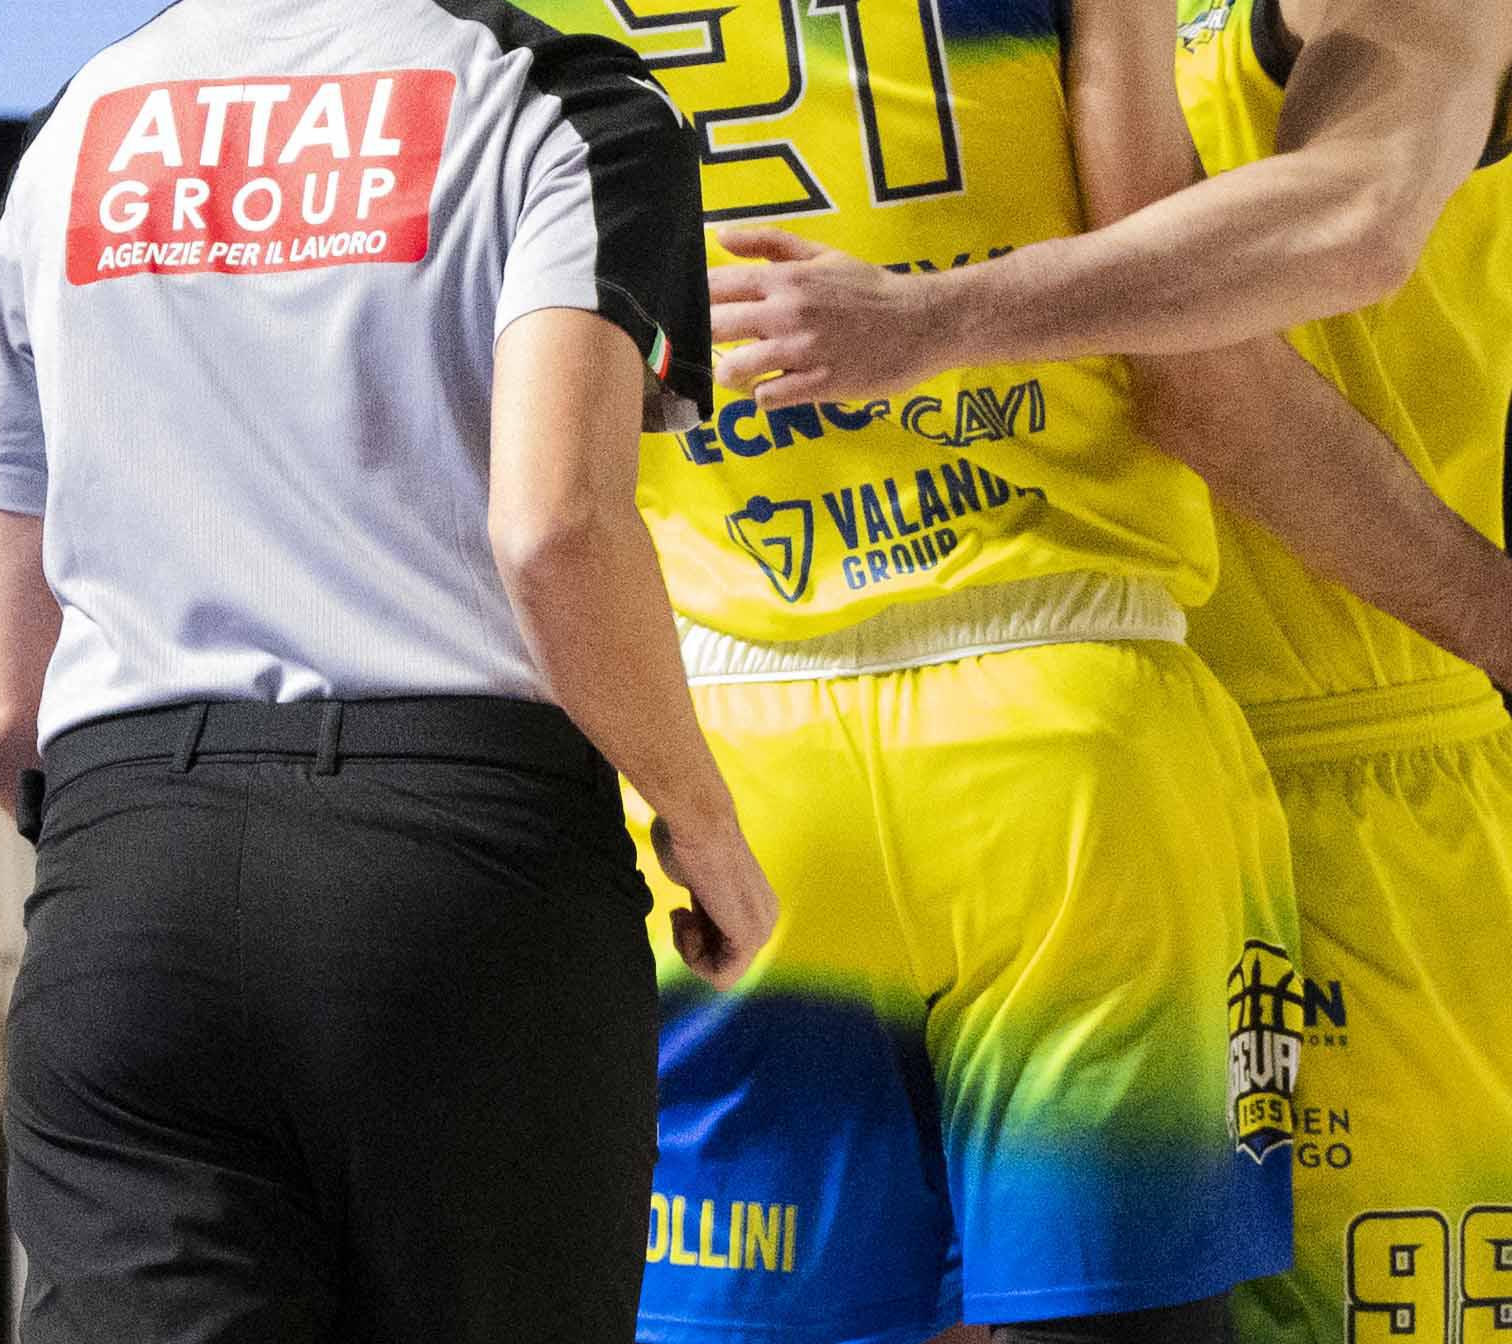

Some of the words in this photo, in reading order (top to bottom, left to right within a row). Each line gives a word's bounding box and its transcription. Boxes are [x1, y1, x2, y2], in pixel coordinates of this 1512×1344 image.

[106, 77, 401, 172] ATTAL
[98, 167, 397, 234] GROUP
[96, 239, 202, 272] AGENZIE
[207, 241, 259, 267] PER
[266, 239, 285, 265] IL
[290, 229, 387, 261] LAVORO
[901, 378, 1046, 447] CAVI
[841, 527, 959, 591] GROUP
